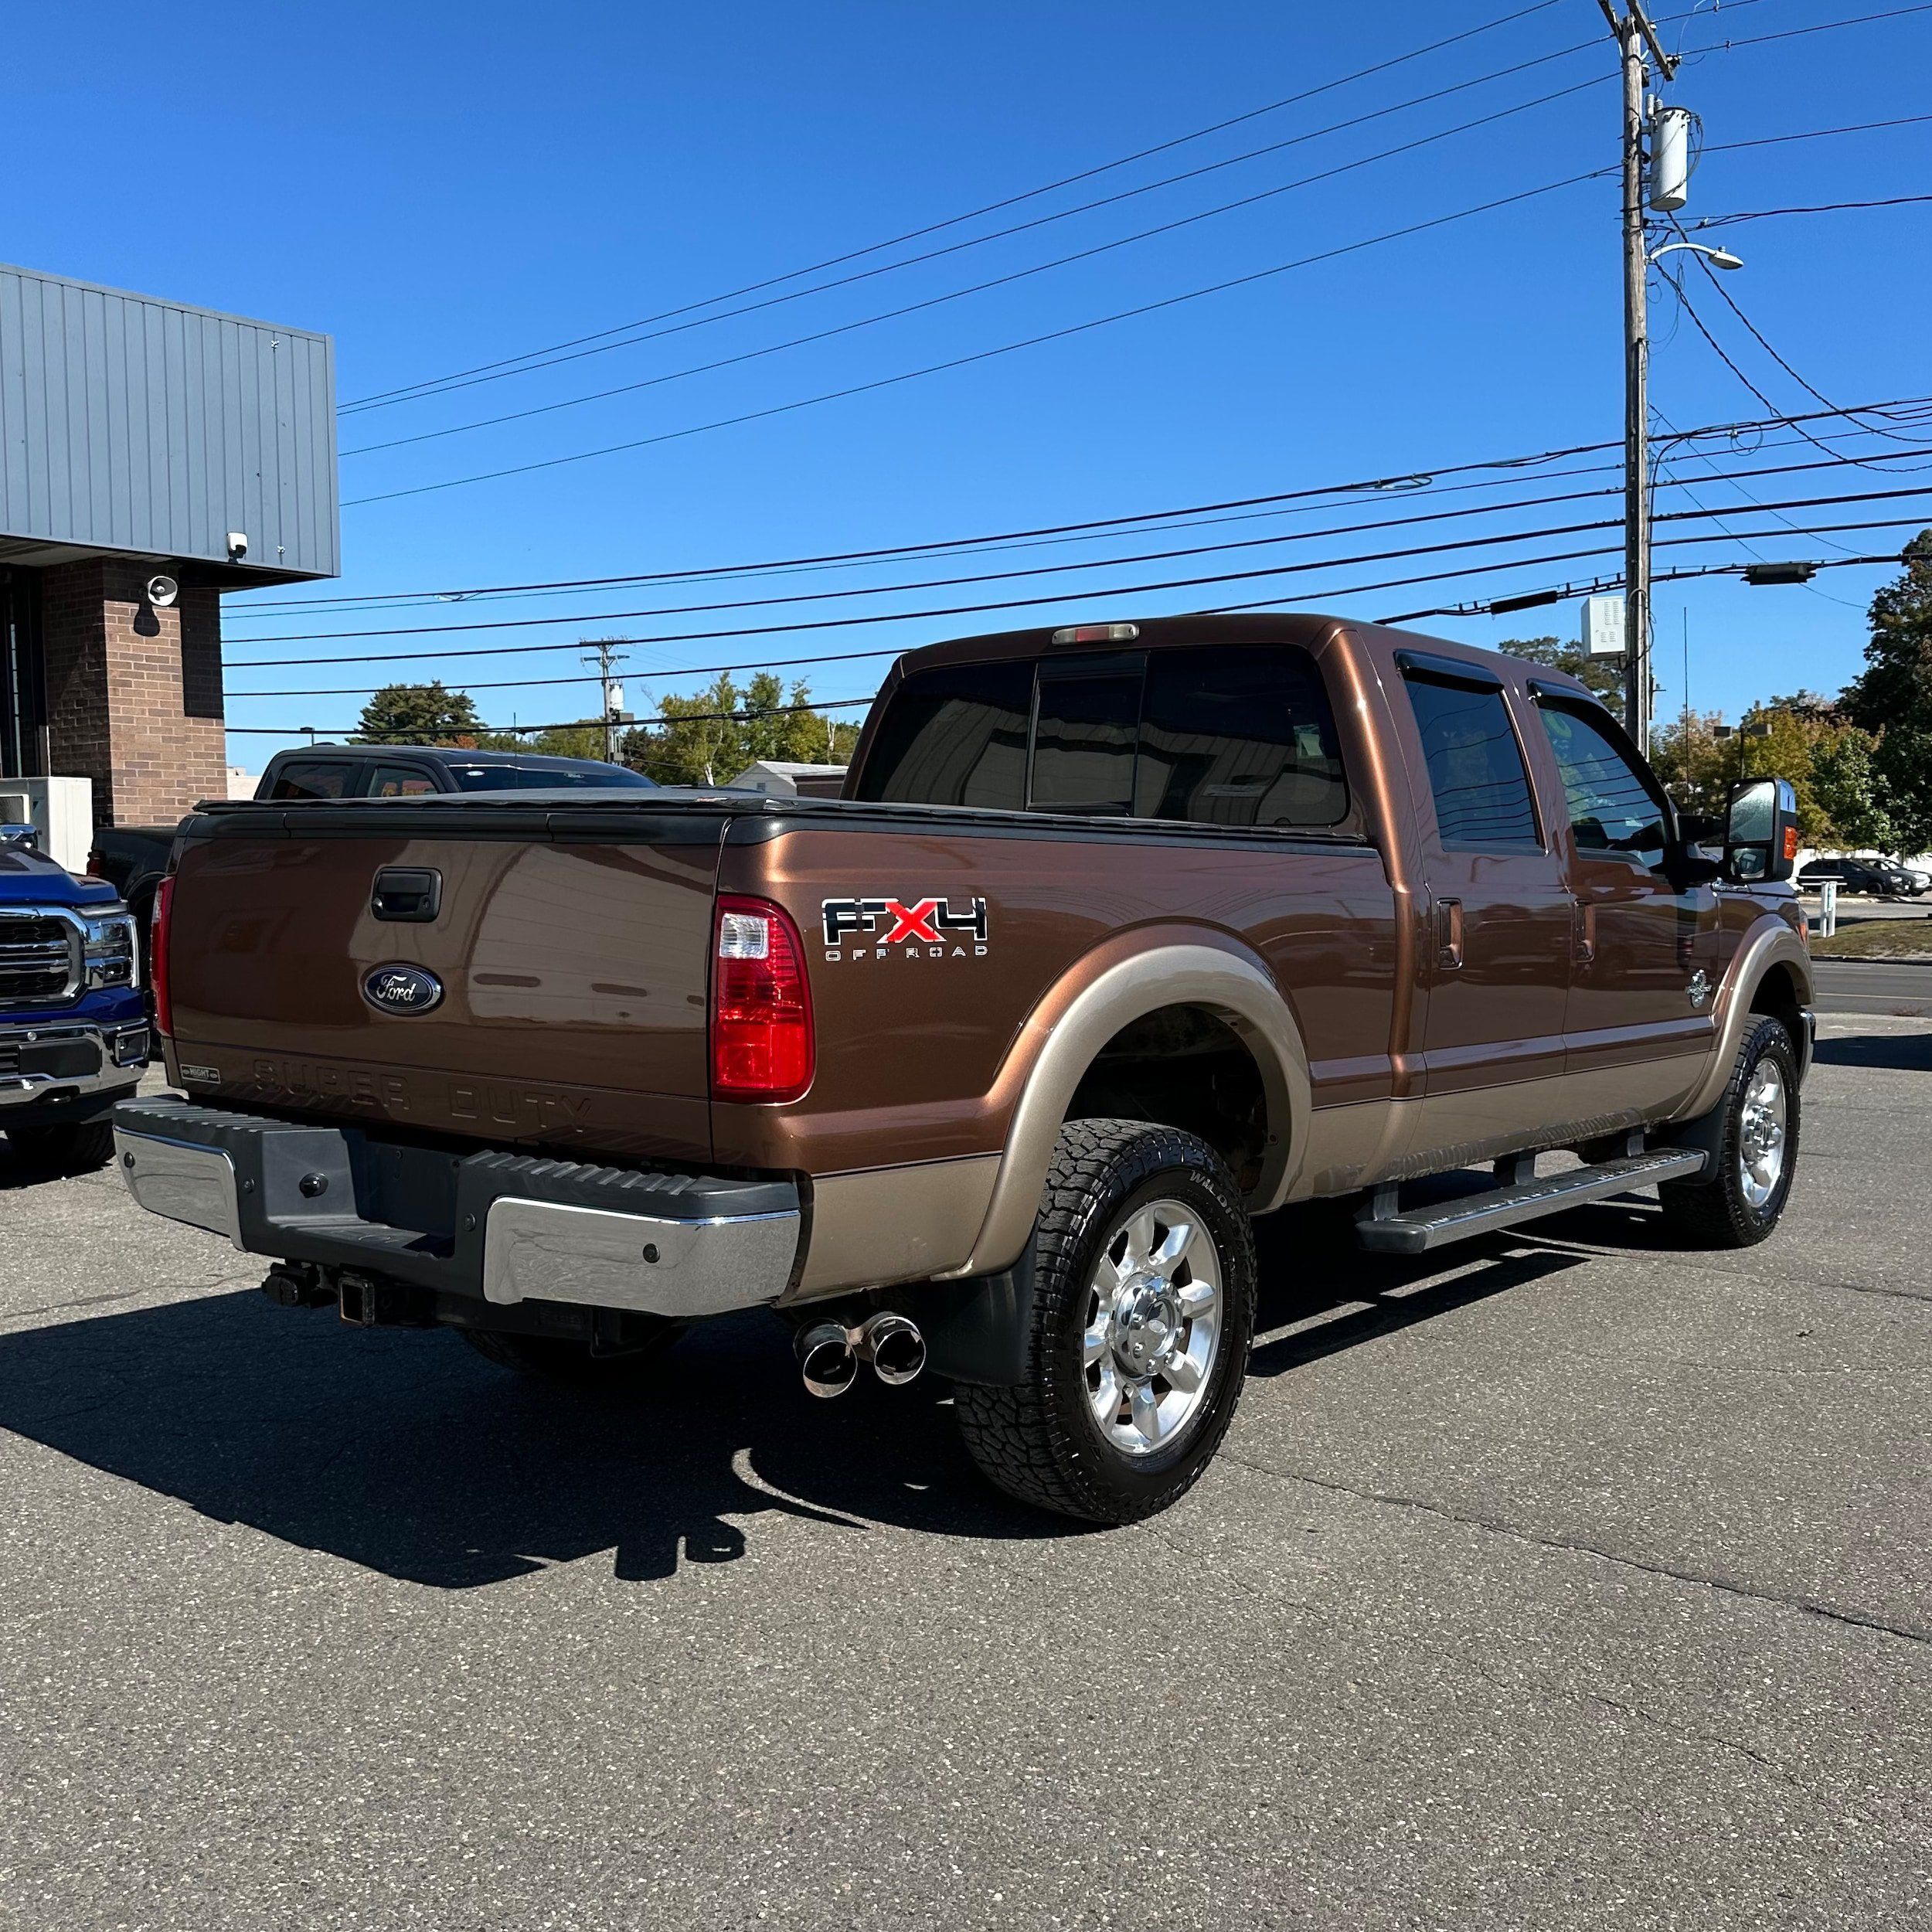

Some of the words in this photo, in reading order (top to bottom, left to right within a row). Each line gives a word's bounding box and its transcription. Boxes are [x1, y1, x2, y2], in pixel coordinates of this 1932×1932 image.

[821, 897, 988, 946] FX4
[825, 948, 890, 961] OFF
[906, 944, 988, 959] ROAD
[376, 974, 417, 1002] Ford
[253, 1060, 413, 1111] SUPER
[447, 1082, 592, 1133] DUTY
